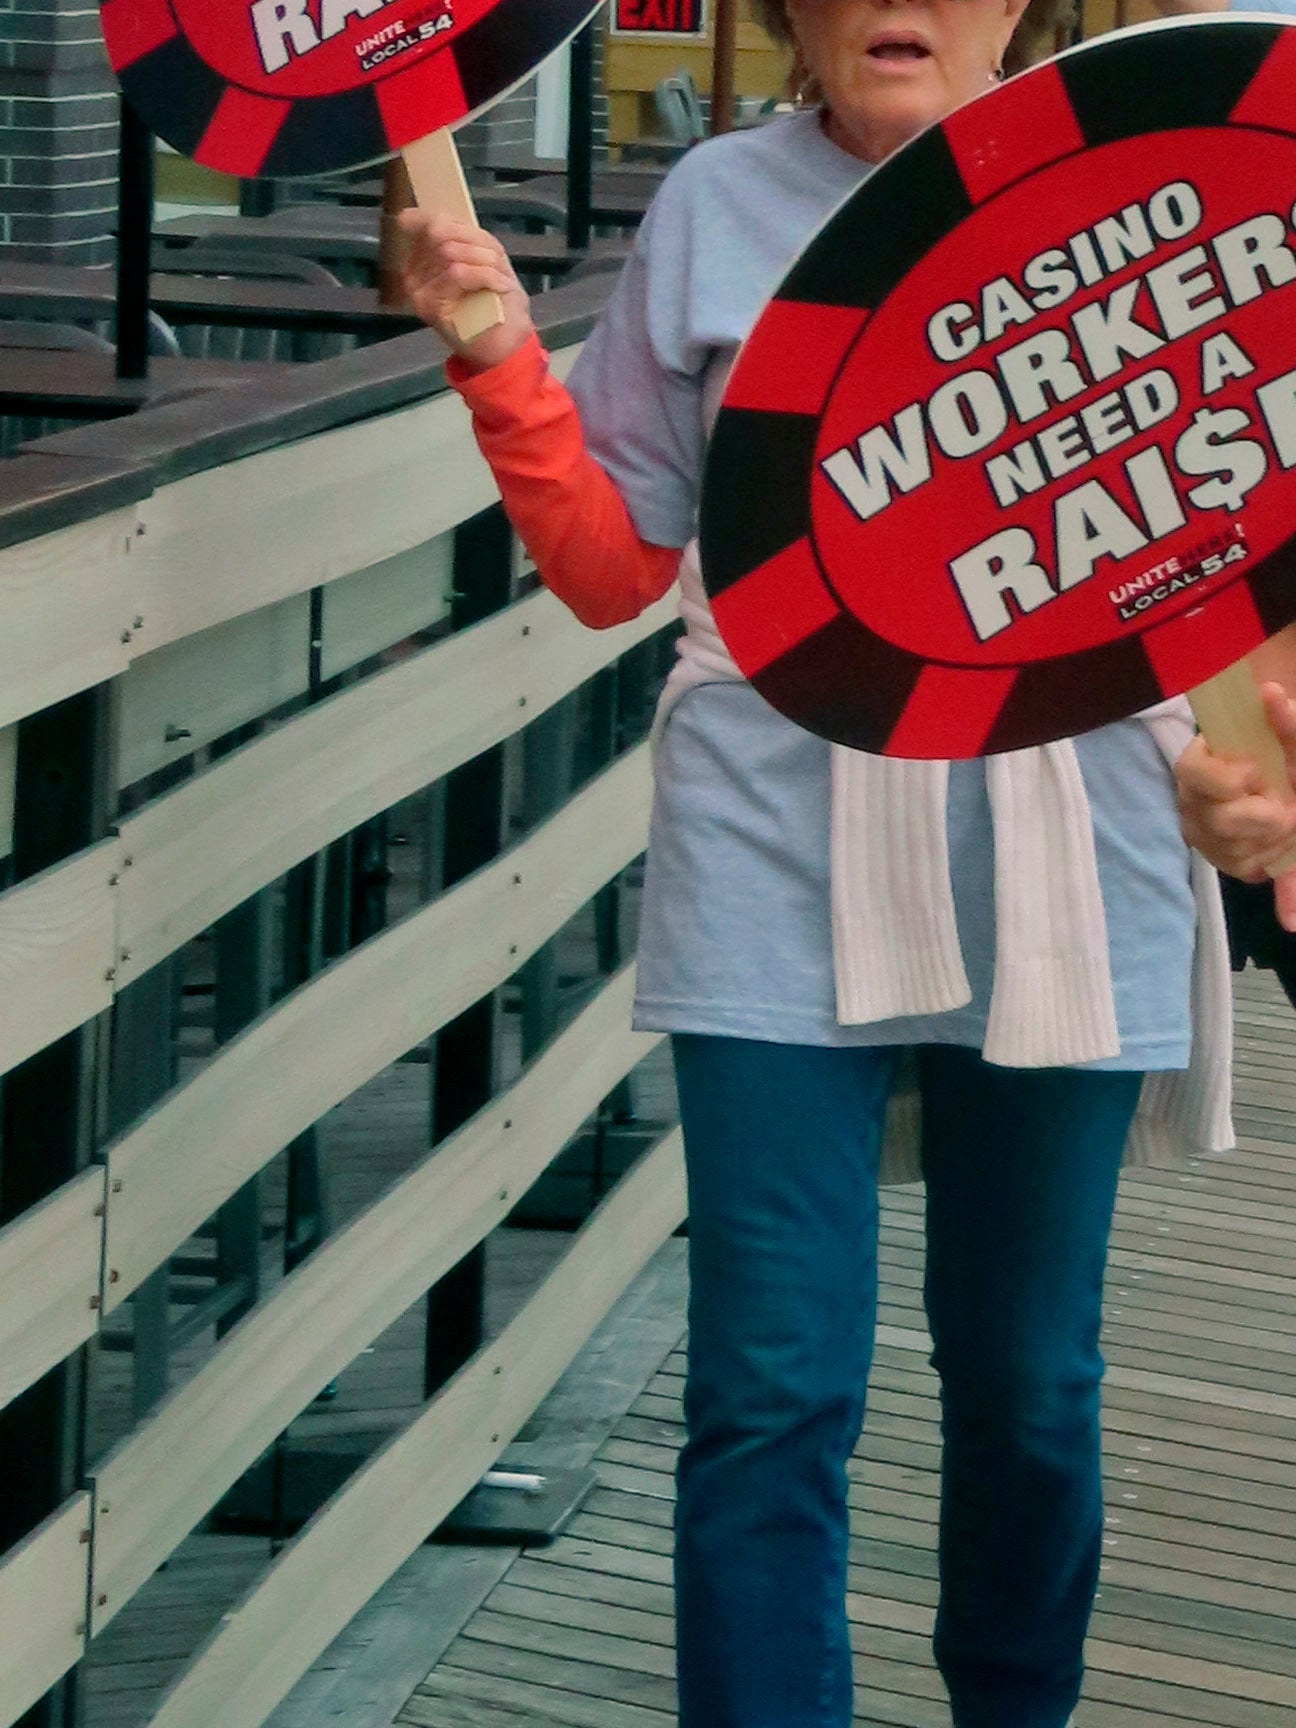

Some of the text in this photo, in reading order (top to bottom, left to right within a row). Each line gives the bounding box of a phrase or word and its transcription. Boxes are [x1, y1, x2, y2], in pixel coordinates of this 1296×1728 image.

[362, 13, 453, 70] LOCAL 54
[927, 181, 1202, 362] CASINO
[984, 333, 1255, 508] NEED A
[1120, 543, 1248, 619] LOCAL 54
